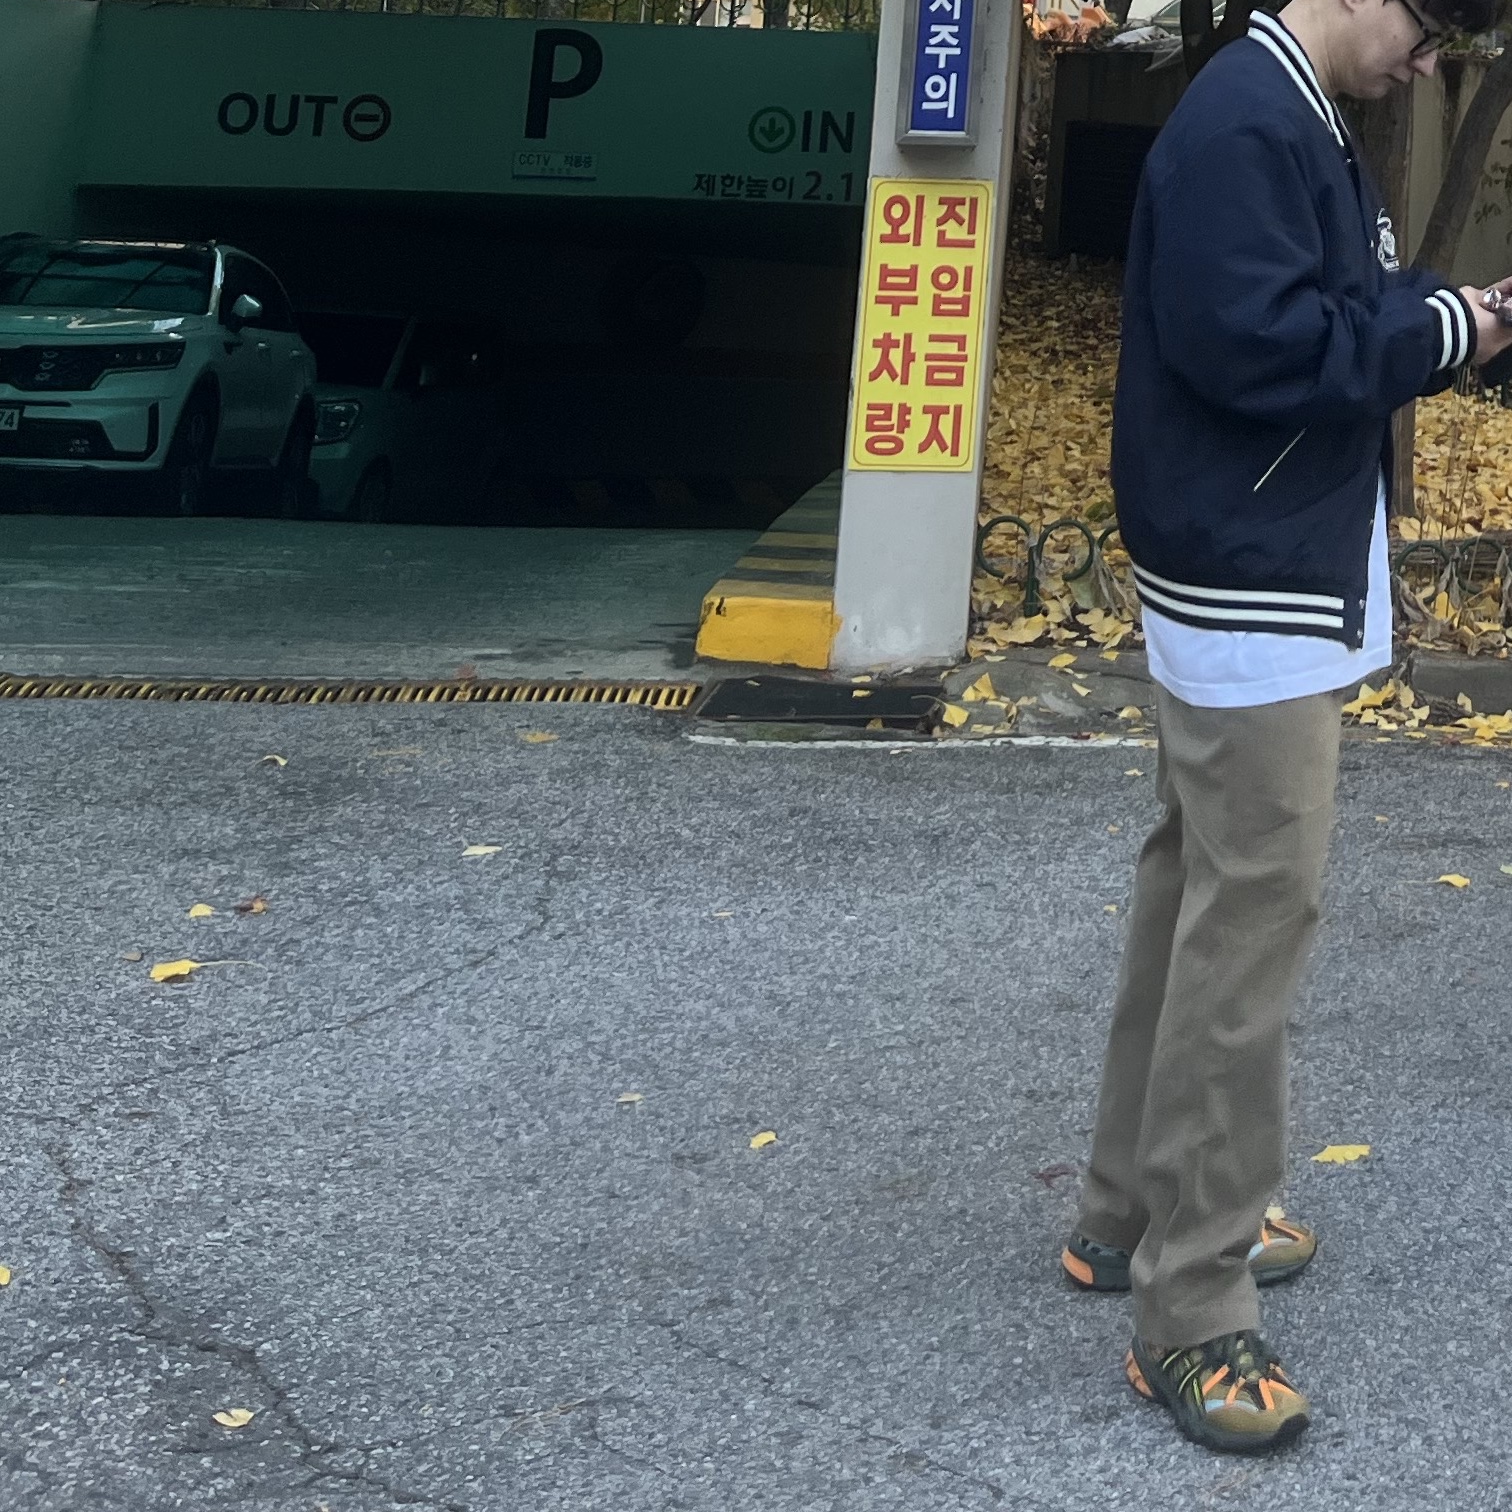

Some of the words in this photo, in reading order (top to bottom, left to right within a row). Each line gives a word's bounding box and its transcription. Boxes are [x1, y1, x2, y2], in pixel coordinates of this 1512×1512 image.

[525, 28, 603, 139] P
[218, 92, 338, 137] OUT
[801, 110, 855, 153] IN
[518, 153, 552, 166] CCTV
[693, 173, 795, 200] 제한높이
